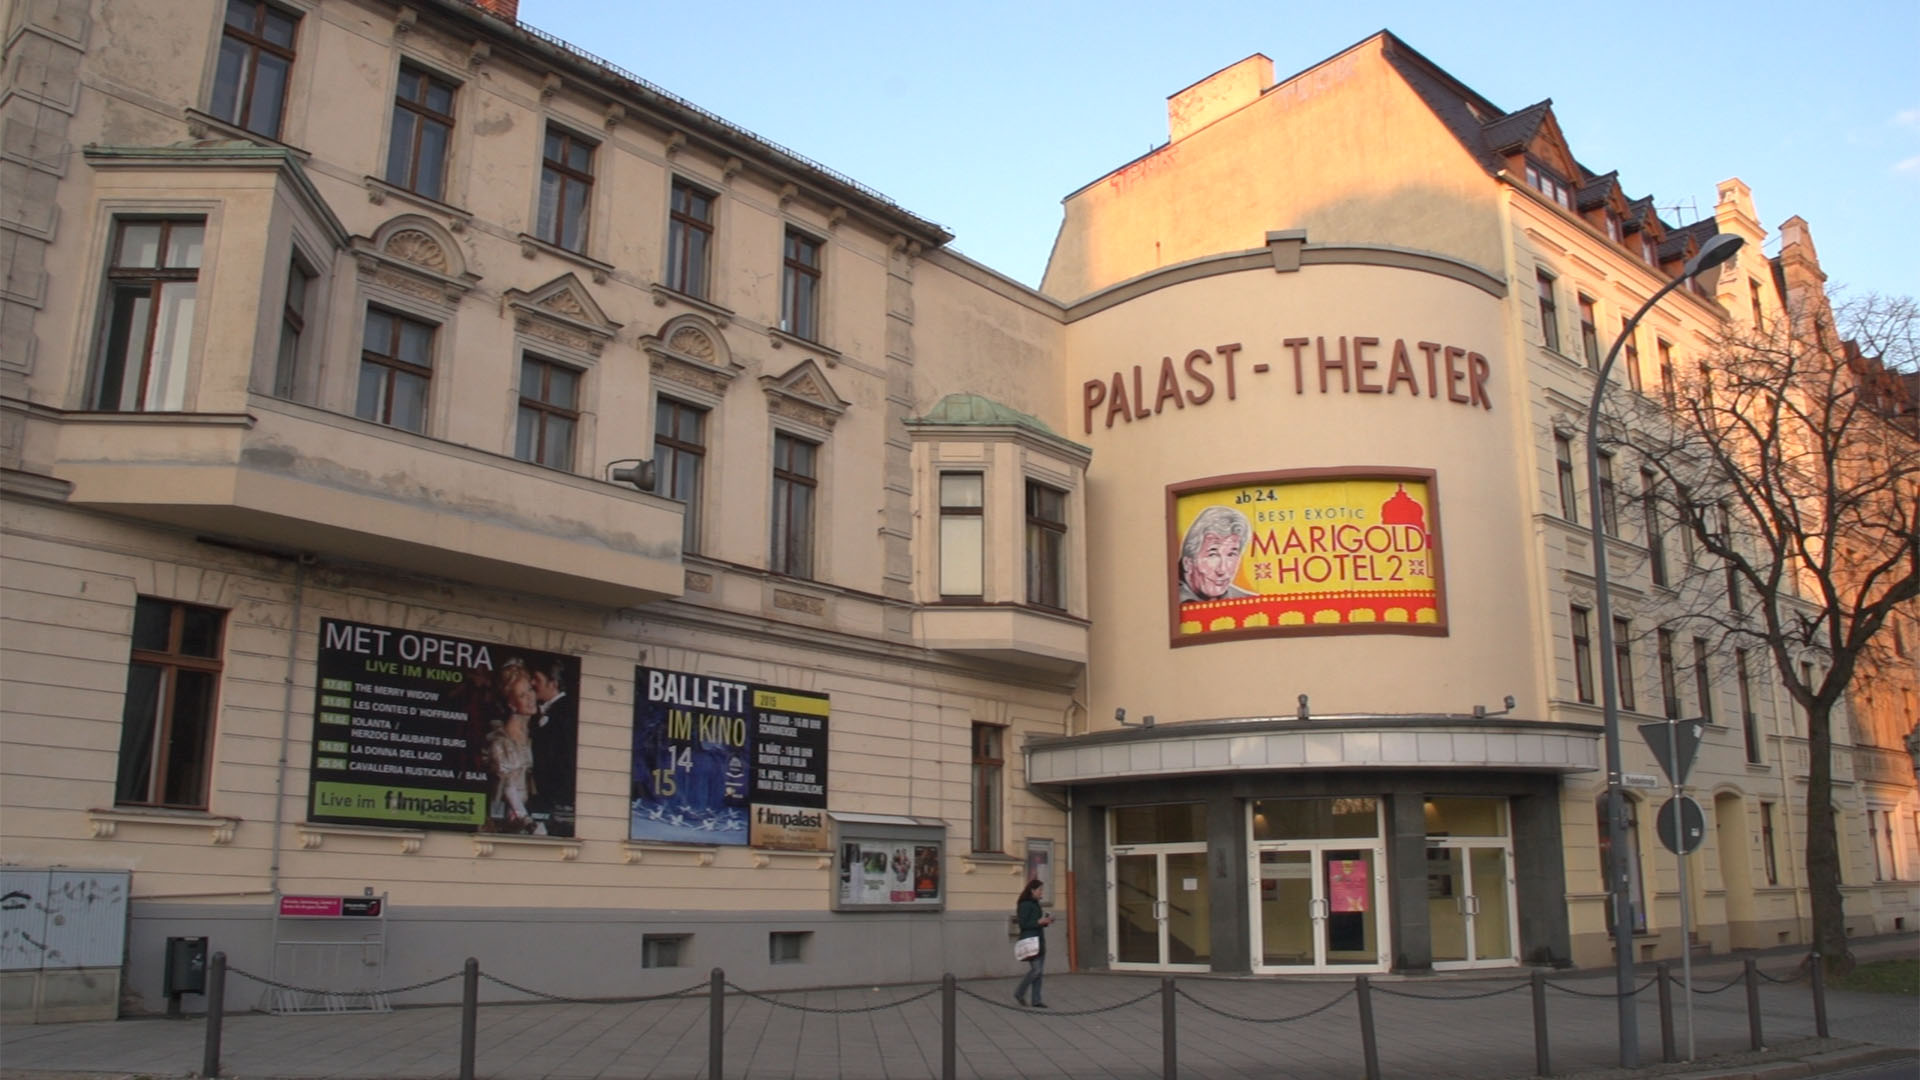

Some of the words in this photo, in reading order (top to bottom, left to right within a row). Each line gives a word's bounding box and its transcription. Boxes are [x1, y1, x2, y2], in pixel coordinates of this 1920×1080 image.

[1084, 342, 1242, 434] PALAST
[1283, 336, 1492, 411] THEATER
[1235, 490, 1251, 504] ab
[1258, 510, 1294, 522] BEST
[1305, 508, 1364, 520] EXOTIC
[1250, 524, 1424, 558] MARIGOLD
[1278, 554, 1382, 584] HOTEL
[1386, 556, 1404, 582] 2
[326, 622, 391, 656] MET
[399, 634, 493, 671] OPERA
[366, 660, 398, 676] LIVE
[403, 664, 422, 679] IM
[426, 667, 463, 684] KINO
[354, 683, 372, 694] THE
[374, 685, 404, 697] MERRY
[407, 688, 440, 701] WIDOW
[648, 670, 748, 713] BALLETT
[353, 701, 370, 710] LES
[372, 702, 408, 714] CONTES
[351, 729, 389, 740] HERZOG
[443, 738, 467, 748] BURG
[668, 709, 692, 740] IM
[699, 714, 746, 747] KINO
[351, 745, 362, 754] LA
[364, 746, 398, 756] DONNA
[400, 749, 416, 759] DEL
[418, 751, 442, 761] LAGO
[668, 745, 693, 773] 14
[349, 762, 403, 774] CAVALLERIA
[405, 766, 455, 778] RUSTICANA
[652, 768, 676, 796] 15
[321, 792, 352, 807] Live
[357, 794, 376, 808] im
